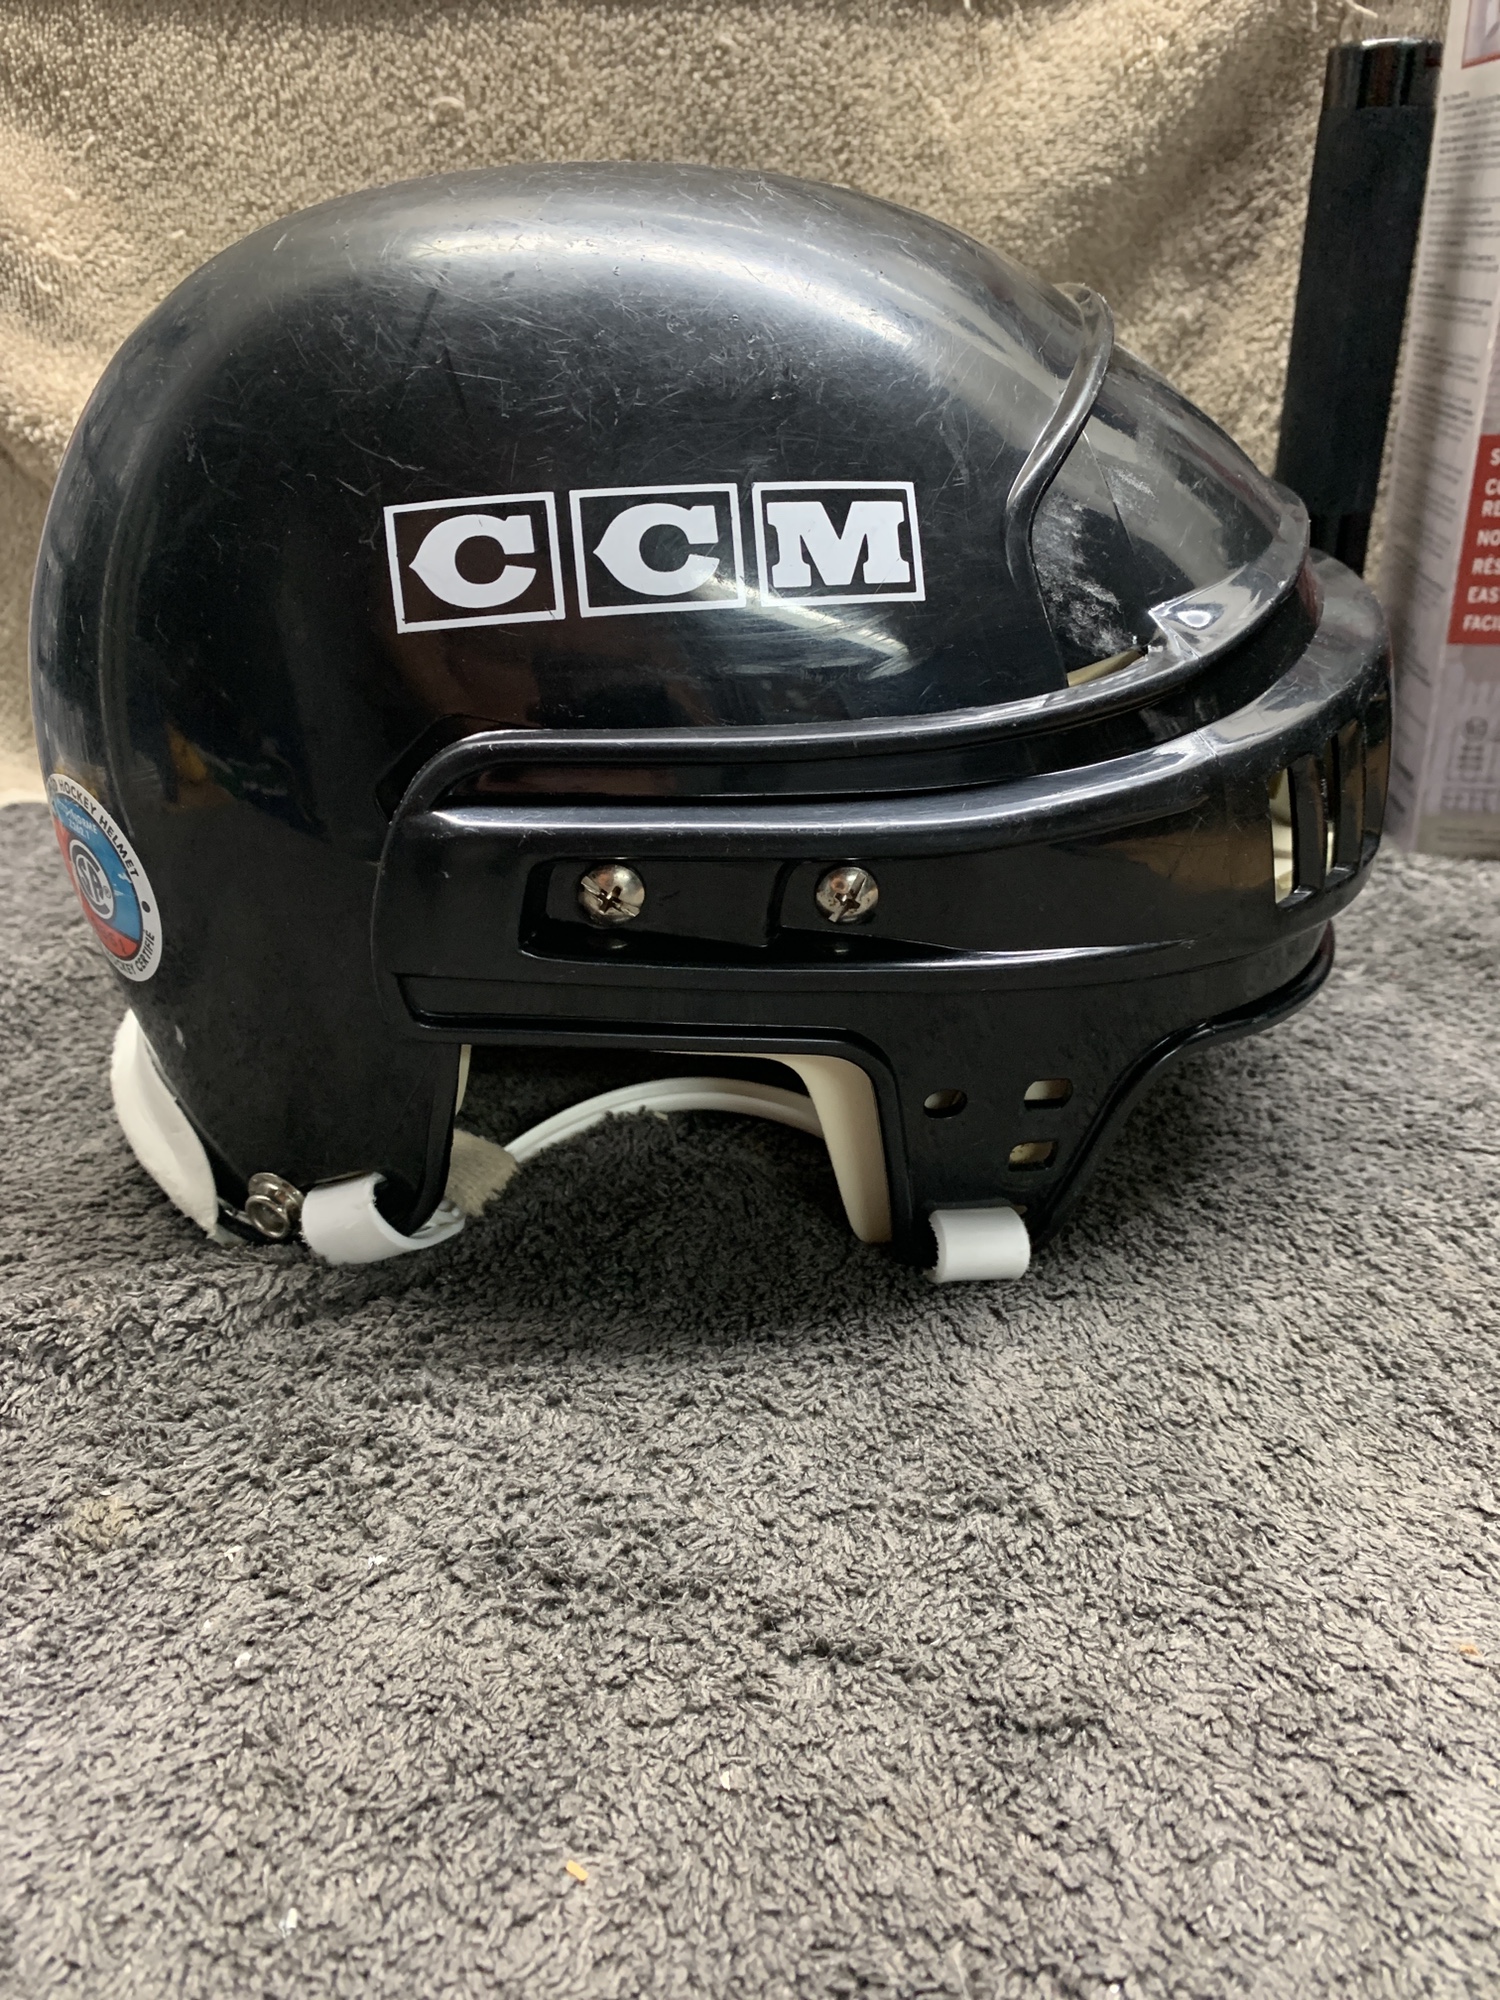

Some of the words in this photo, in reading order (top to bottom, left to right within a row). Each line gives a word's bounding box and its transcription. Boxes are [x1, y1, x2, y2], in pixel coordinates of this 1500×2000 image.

[409, 501, 910, 608] CCM
[59, 779, 97, 815] HOCKEY
[99, 814, 140, 877] HELMET
